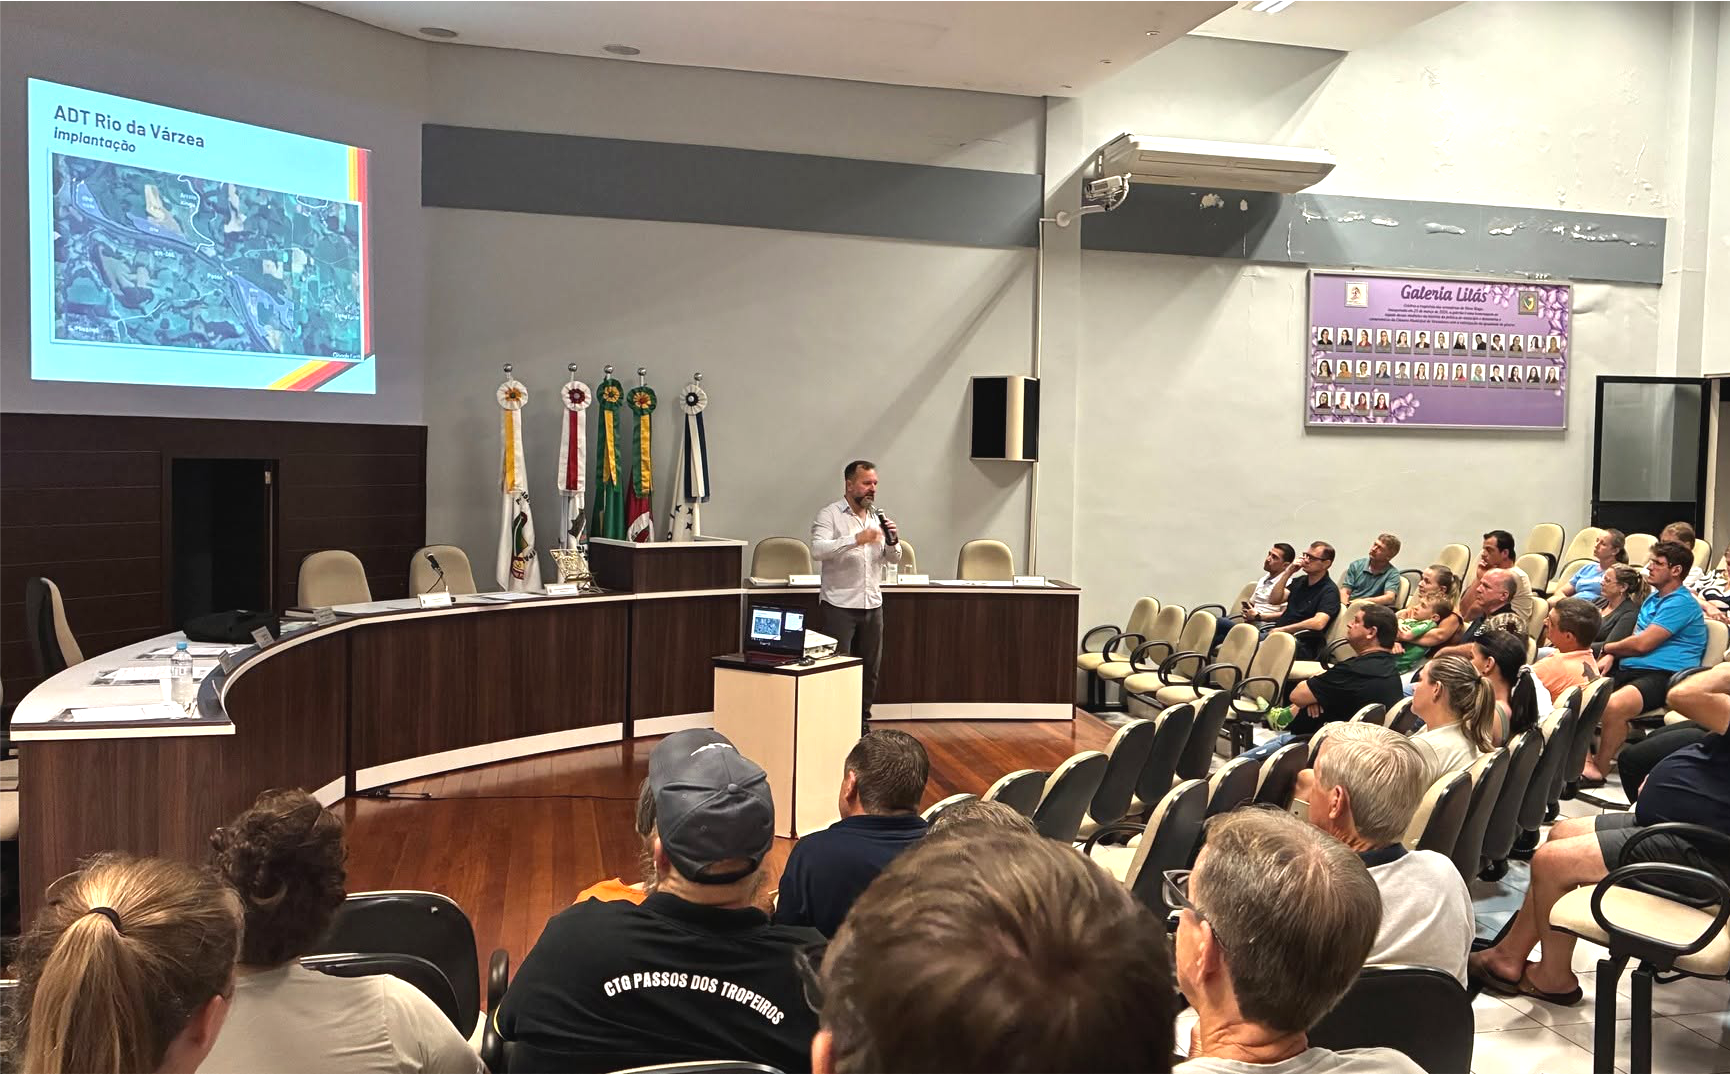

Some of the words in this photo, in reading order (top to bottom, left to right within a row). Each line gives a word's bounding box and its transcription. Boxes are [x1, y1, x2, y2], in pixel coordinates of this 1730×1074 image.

[54, 105, 91, 125] ADT
[95, 113, 122, 131] Rio
[126, 120, 146, 137] da
[150, 123, 205, 148] Várzea
[1401, 284, 1453, 301] Galeria
[1456, 286, 1488, 303] Lilás
[604, 975, 632, 997] CTG
[633, 972, 688, 989] PASSOS
[690, 974, 719, 993] DOS
[721, 981, 785, 1025] TROPEIROS
